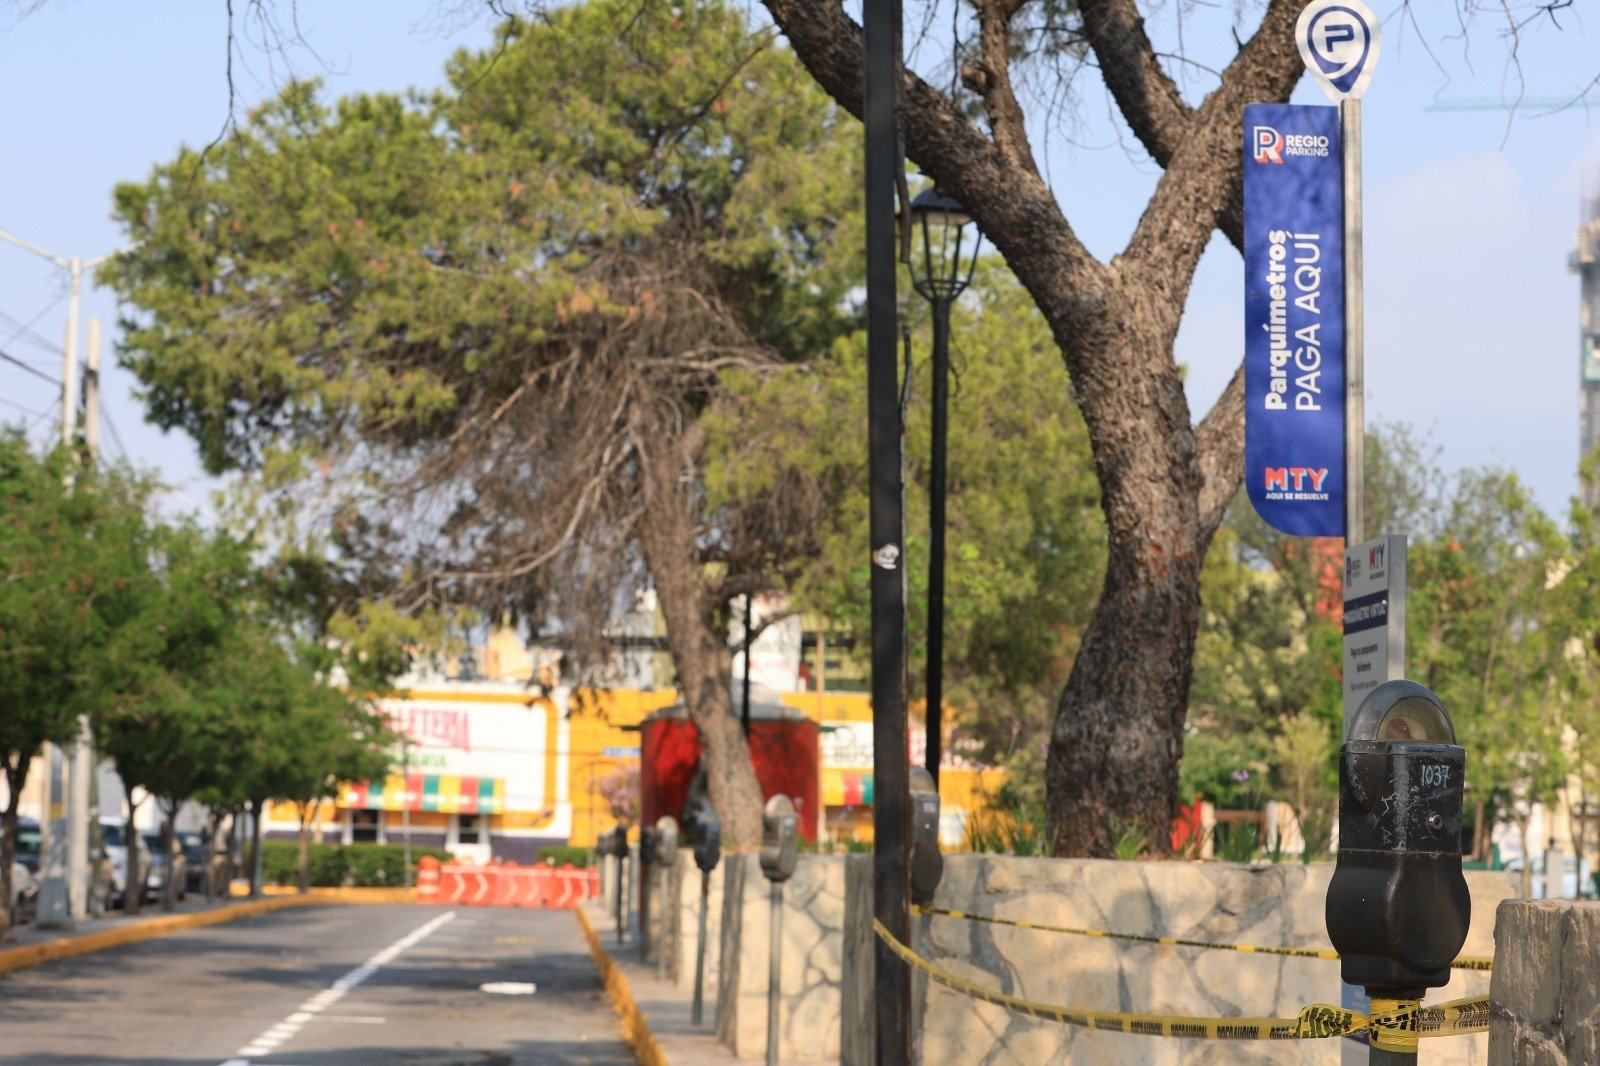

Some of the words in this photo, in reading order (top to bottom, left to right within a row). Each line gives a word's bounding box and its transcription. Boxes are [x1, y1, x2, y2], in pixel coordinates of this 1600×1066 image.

[1285, 134, 1330, 148] REGIO
[1285, 147, 1330, 157] PARKING
[1286, 231, 1322, 315] AQUÍ
[1262, 229, 1293, 410] Parquímetros
[1294, 323, 1322, 411] PAGA
[1265, 467, 1329, 492] MTY
[1294, 493, 1329, 501] RESUELVE
[1420, 764, 1451, 789] 1037
